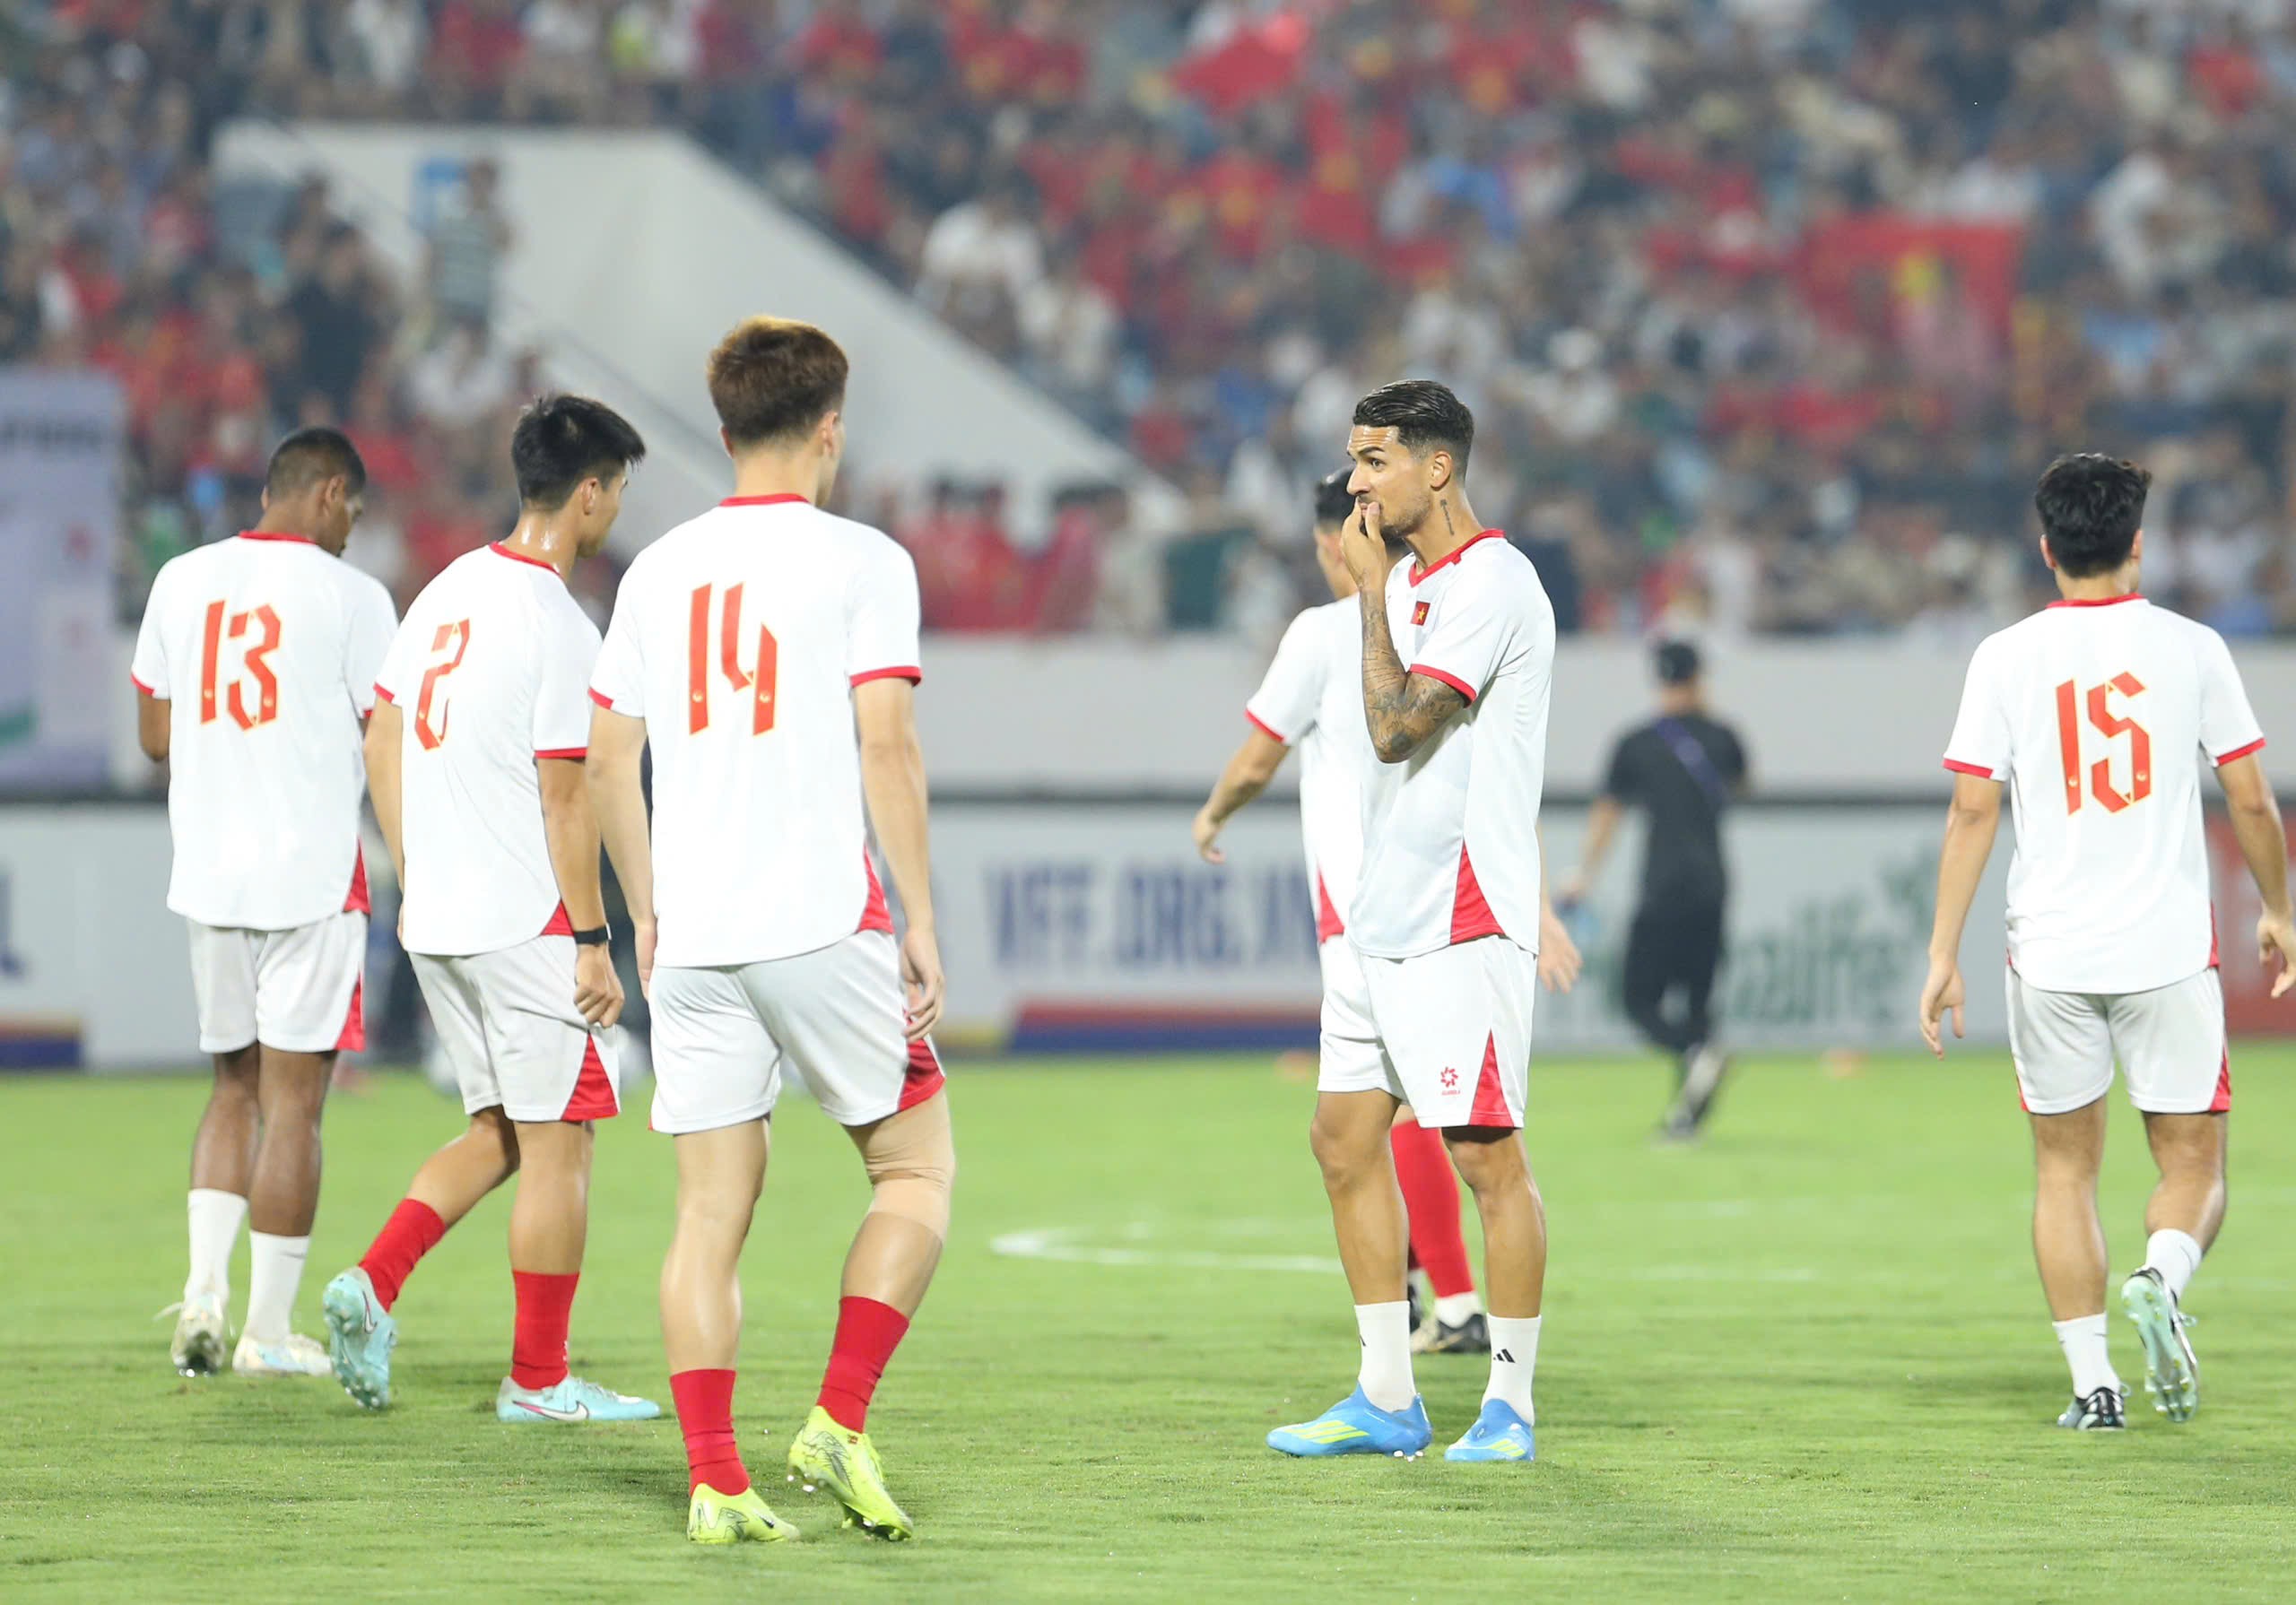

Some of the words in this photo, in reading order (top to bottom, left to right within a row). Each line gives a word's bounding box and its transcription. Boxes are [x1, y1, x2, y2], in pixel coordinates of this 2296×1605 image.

[200, 600, 283, 733] 13
[415, 619, 471, 752] 2
[688, 582, 778, 737] 14
[2055, 671, 2152, 817] 15
